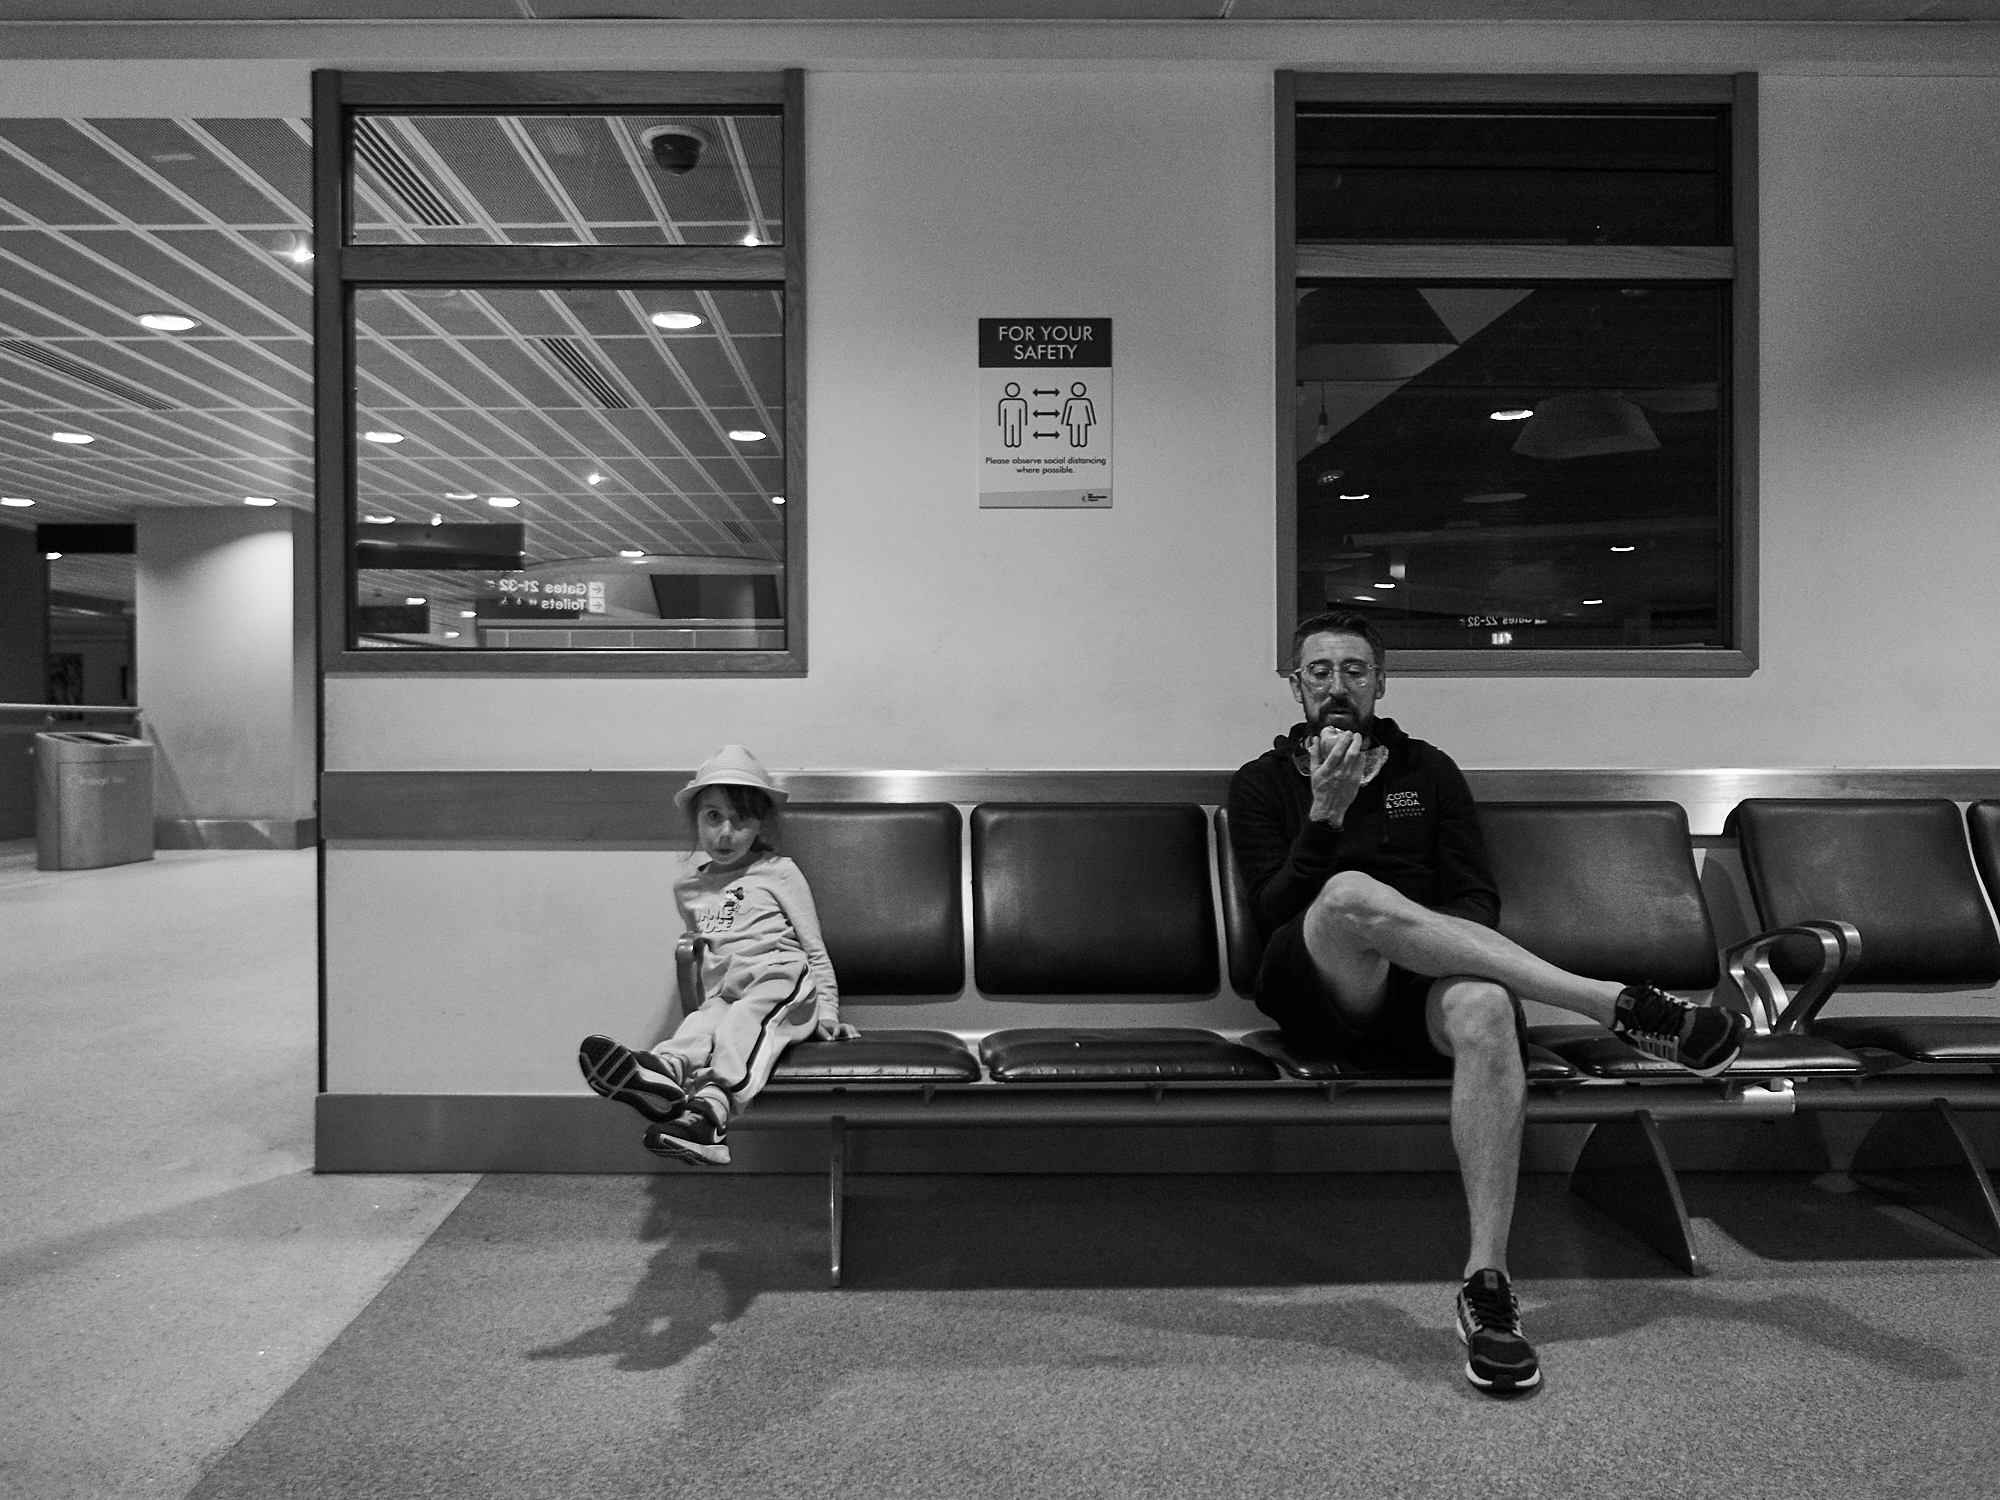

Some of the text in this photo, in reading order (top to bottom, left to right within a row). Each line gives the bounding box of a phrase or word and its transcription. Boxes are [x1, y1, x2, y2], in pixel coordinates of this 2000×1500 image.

[999, 325, 1093, 341] FOR YOUR
[1014, 344, 1078, 360] SAFETY
[985, 457, 1107, 466] Please observe social distancing
[1016, 466, 1076, 476] where possible.
[1386, 791, 1419, 801] COTCH
[1385, 799, 1421, 809] & SODA
